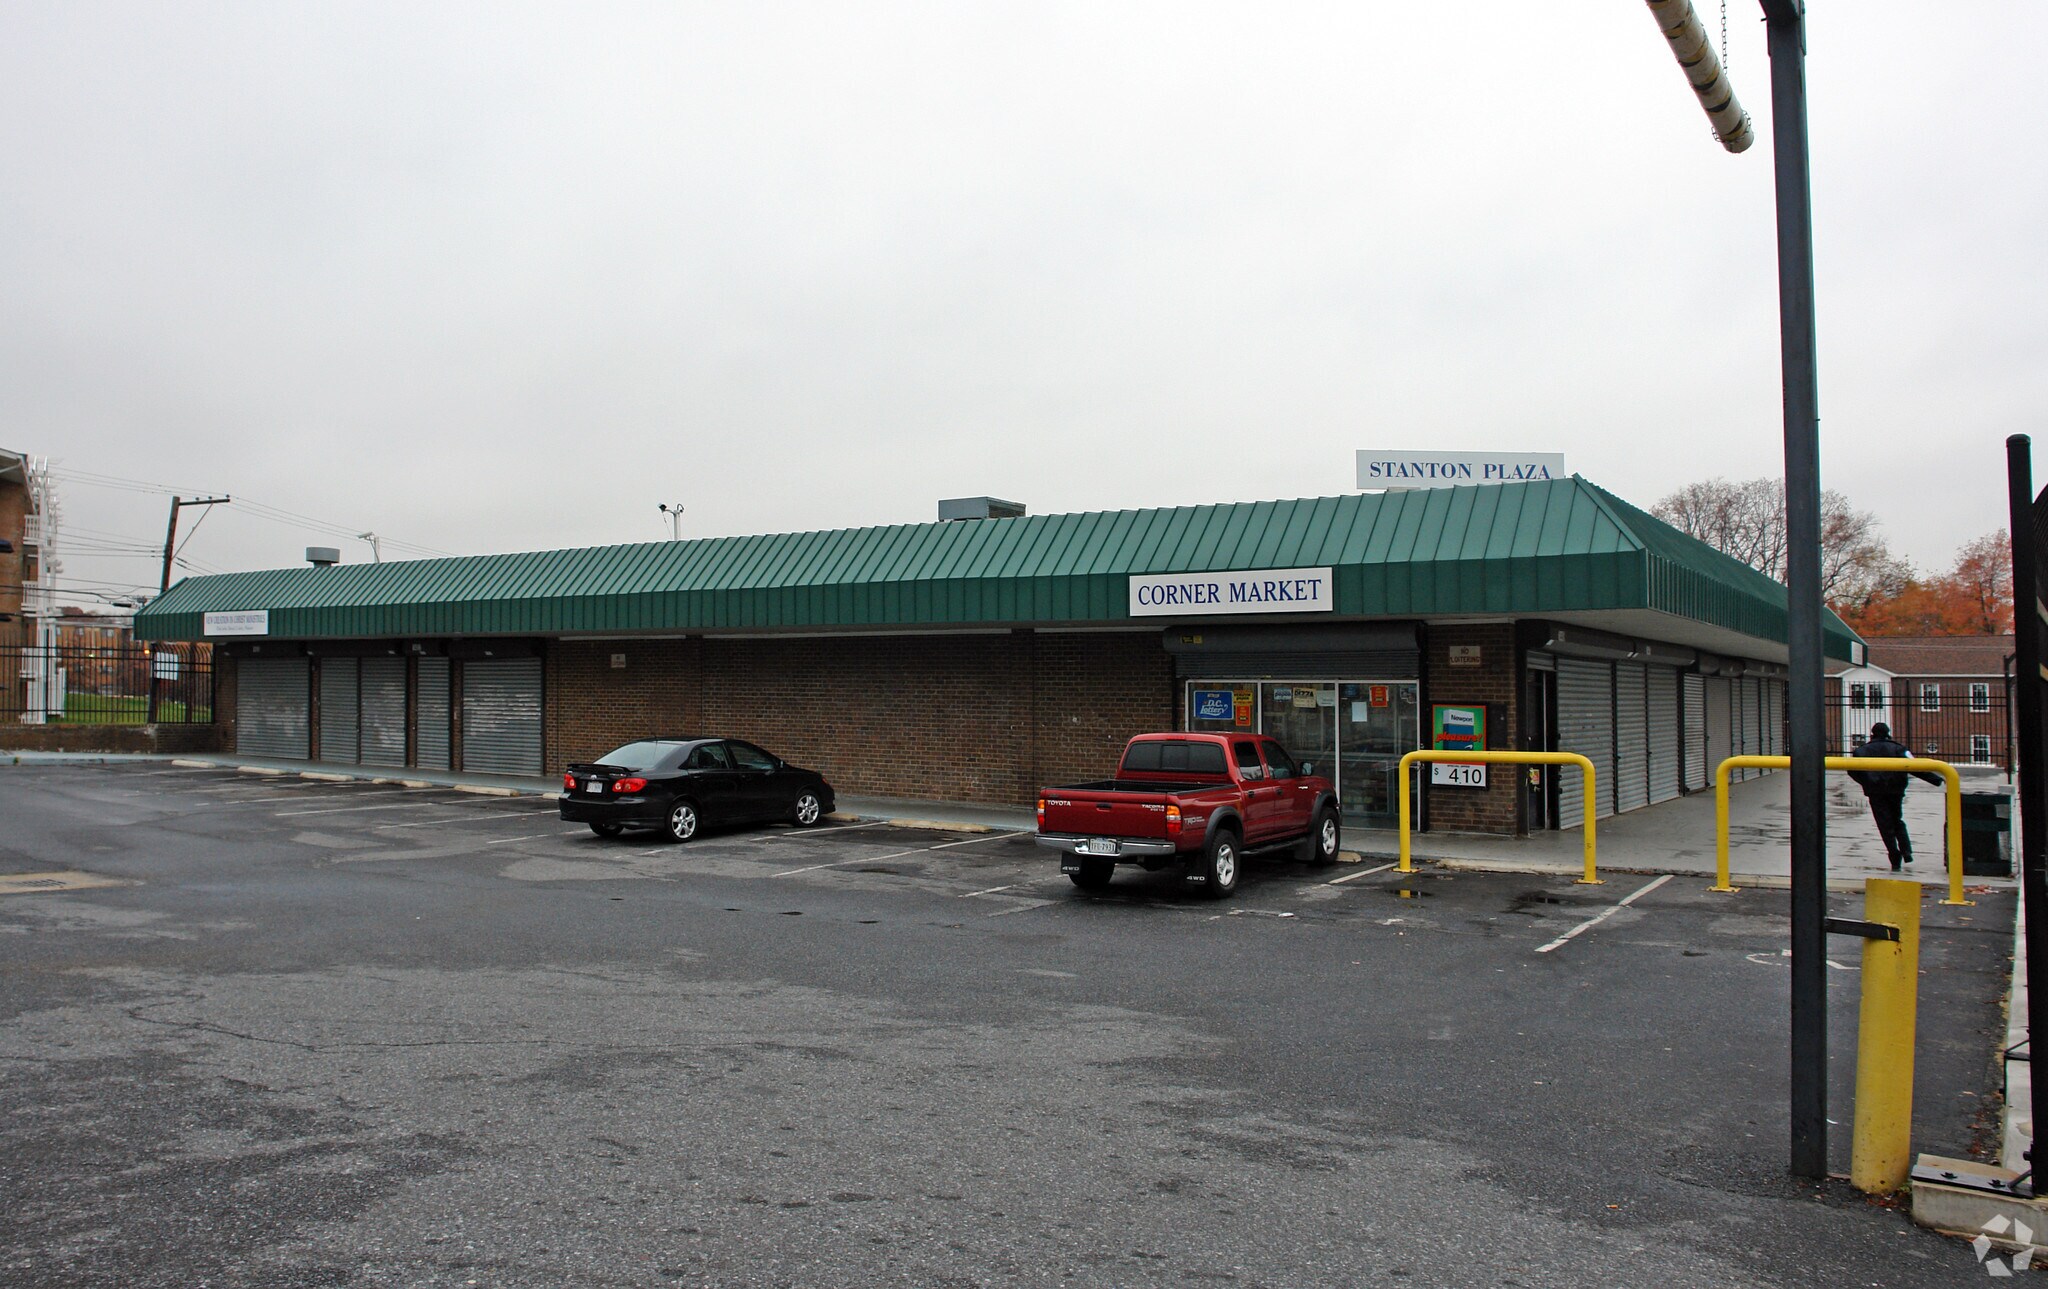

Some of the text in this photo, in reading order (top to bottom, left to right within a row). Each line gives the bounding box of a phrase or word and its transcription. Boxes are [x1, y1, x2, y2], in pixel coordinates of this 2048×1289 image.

[1369, 461, 1551, 480] STANTON PLAZA
[1138, 579, 1322, 606] CORNER MARKET
[1460, 646, 1470, 655] NO
[1451, 714, 1473, 723] Newport
[1433, 767, 1439, 776] $
[1047, 799, 1072, 807] TOYOTA
